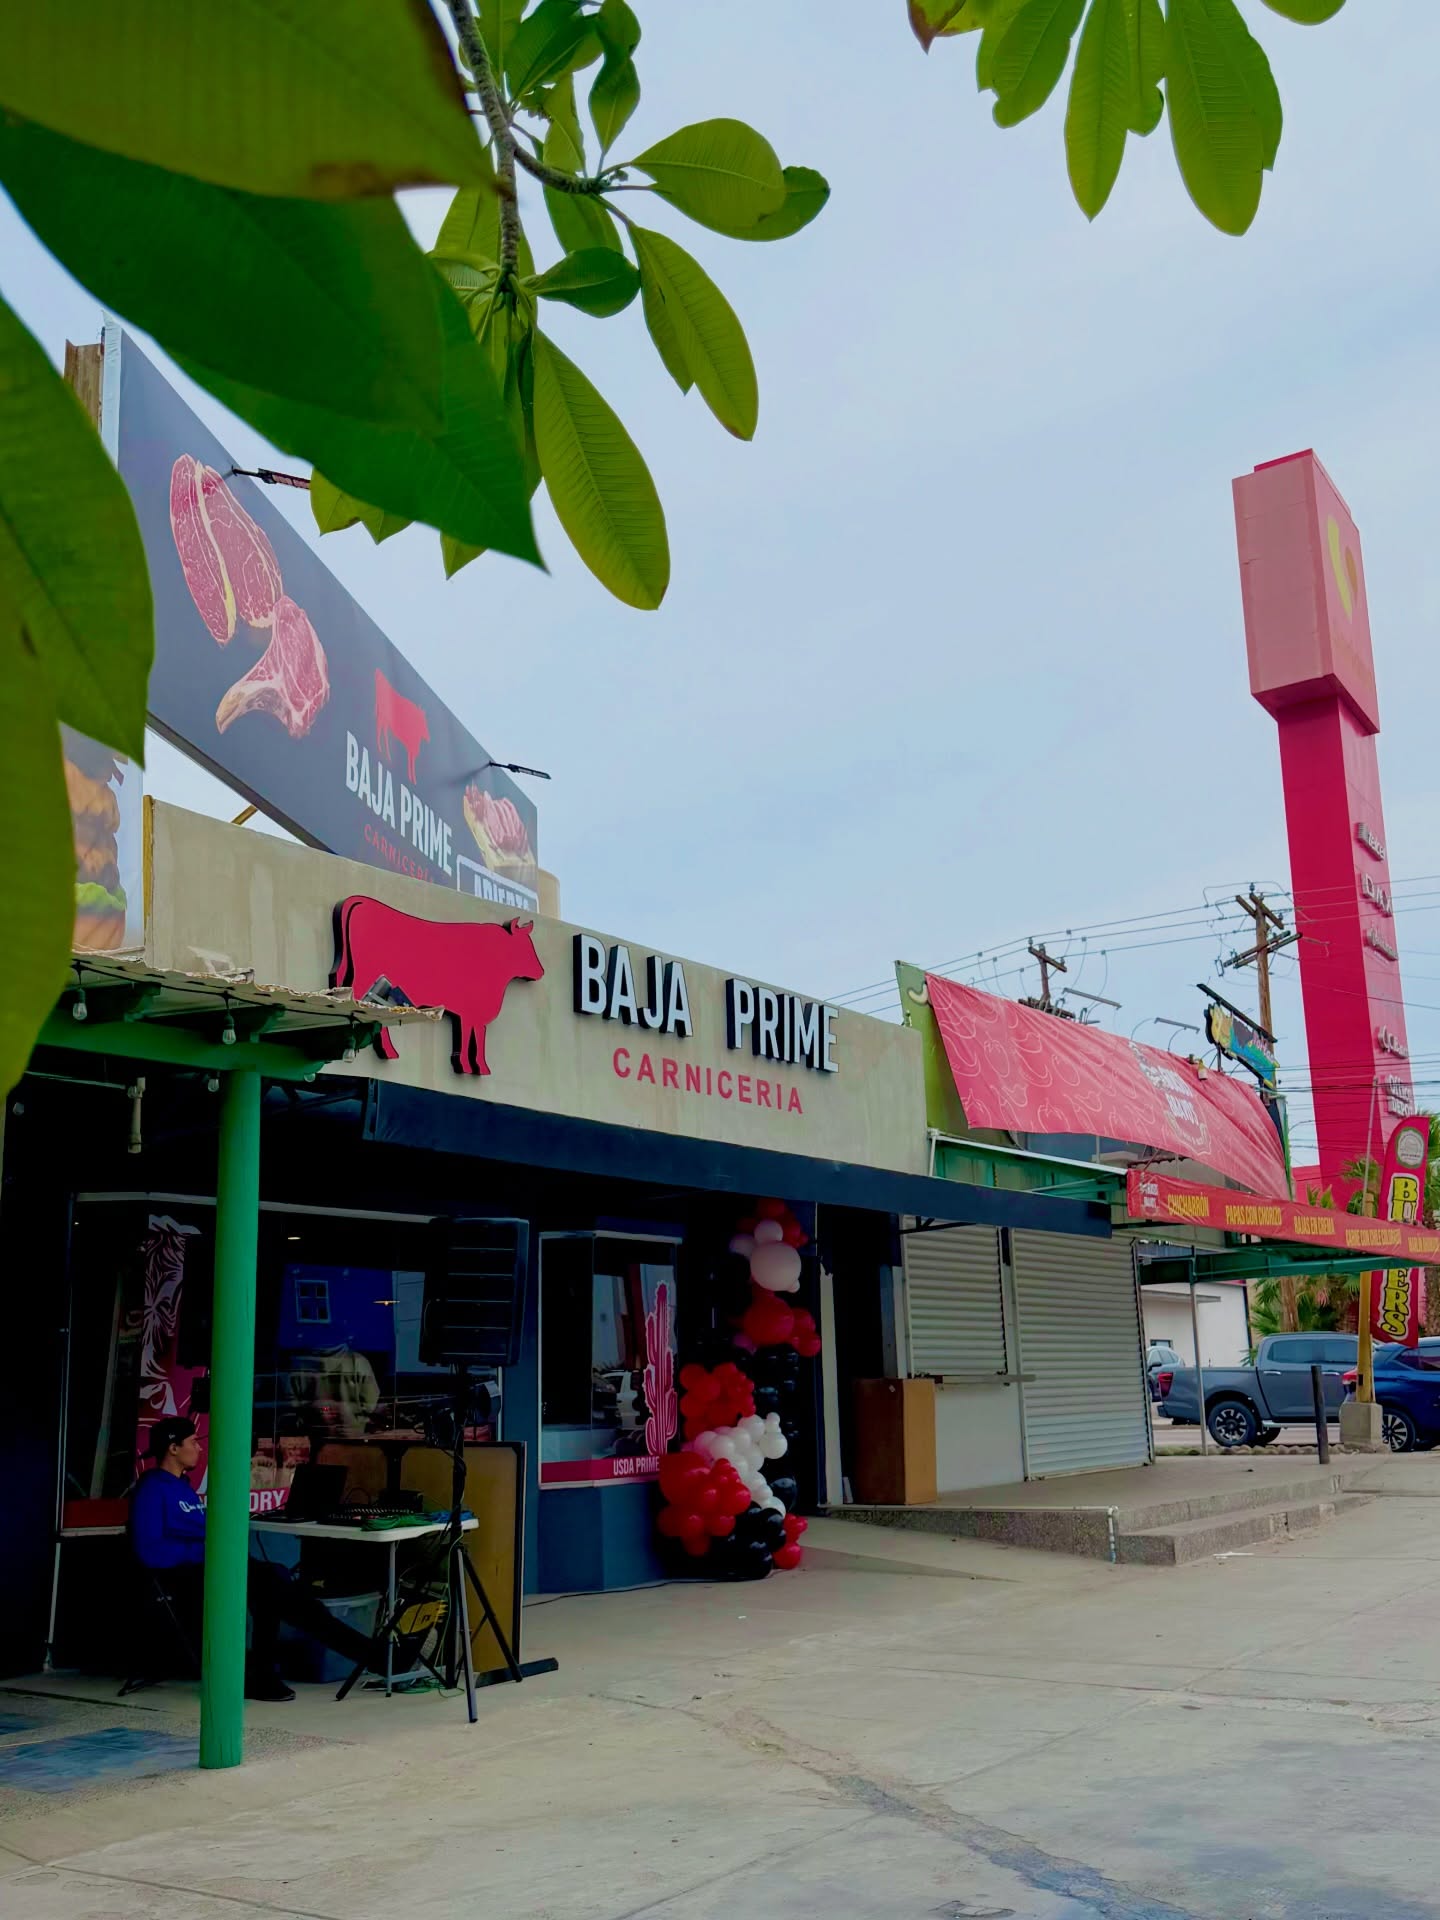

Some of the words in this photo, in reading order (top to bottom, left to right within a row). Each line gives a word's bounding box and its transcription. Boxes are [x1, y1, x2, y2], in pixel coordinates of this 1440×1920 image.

[346, 730, 396, 830] BAJA
[400, 784, 453, 877] PRIME
[363, 823, 433, 884] CARNICERI
[573, 933, 693, 1038] BAJA
[725, 977, 840, 1074] PRIME
[612, 1046, 804, 1115] CARNICERIA
[613, 1457, 635, 1476] USDA
[636, 1455, 660, 1474] PRIME
